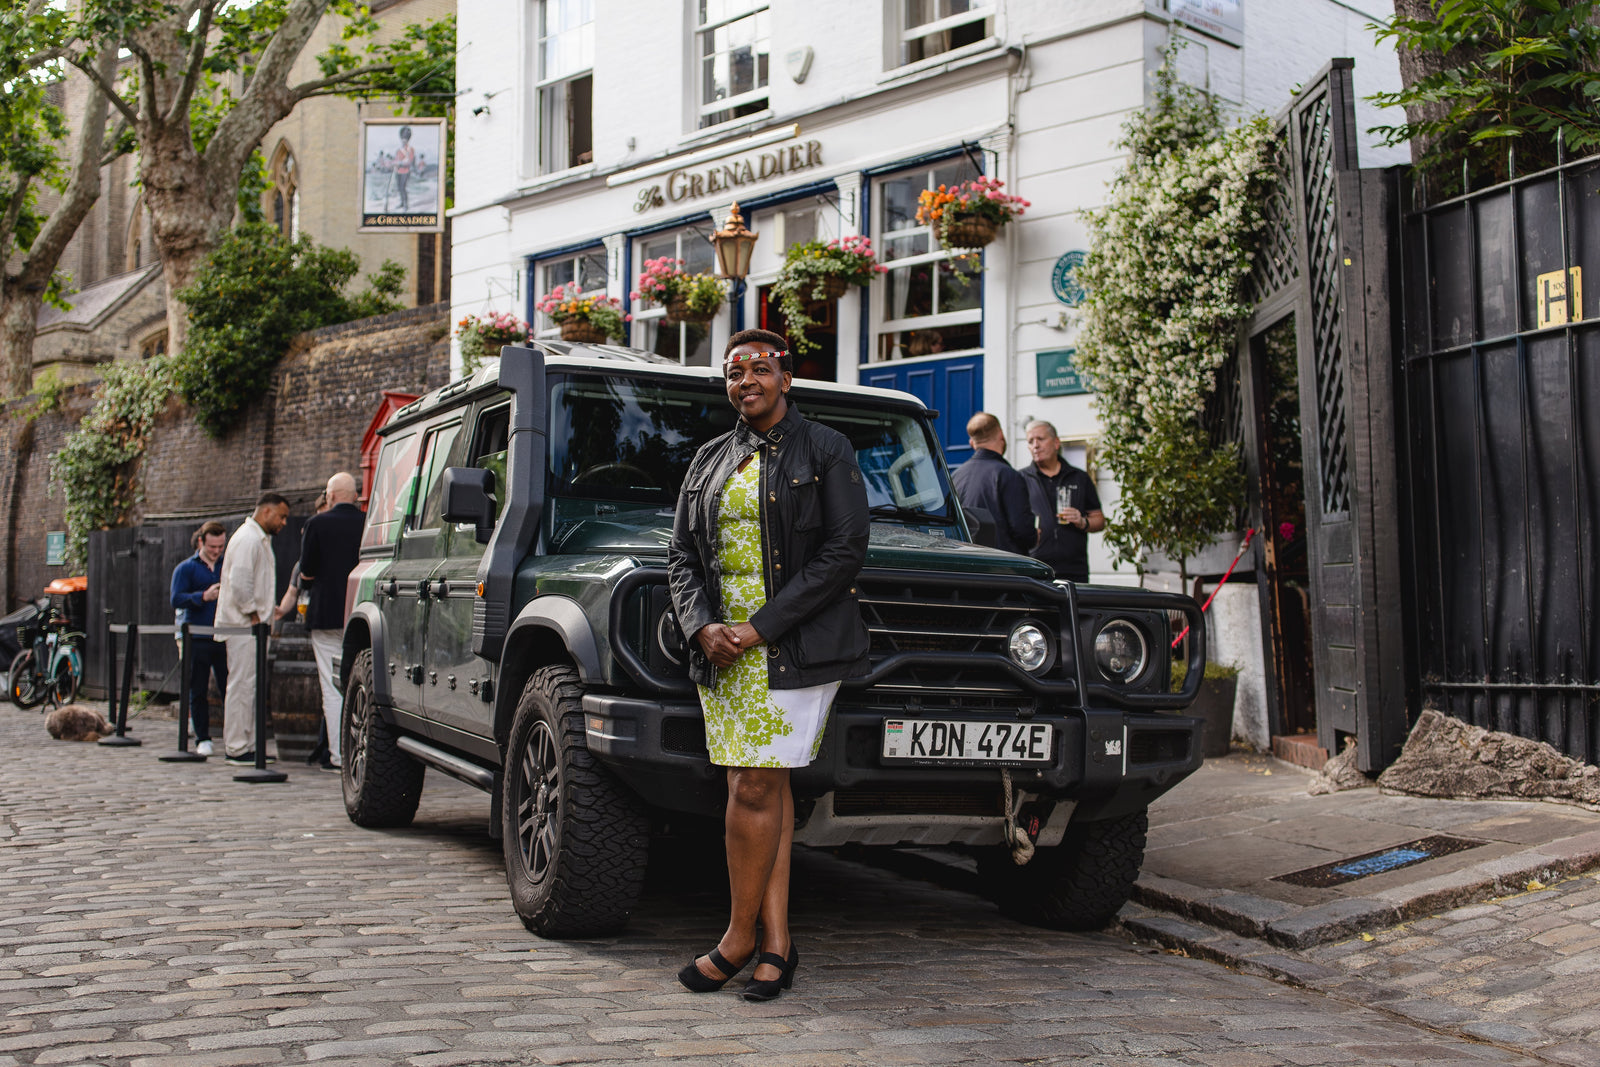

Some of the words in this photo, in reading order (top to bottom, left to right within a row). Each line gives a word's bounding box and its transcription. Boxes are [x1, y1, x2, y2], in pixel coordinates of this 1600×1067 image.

[666, 139, 824, 201] GRENADIER
[377, 215, 436, 225] GRENADIER
[910, 722, 966, 757] KDN
[977, 724, 1046, 758] 474E
